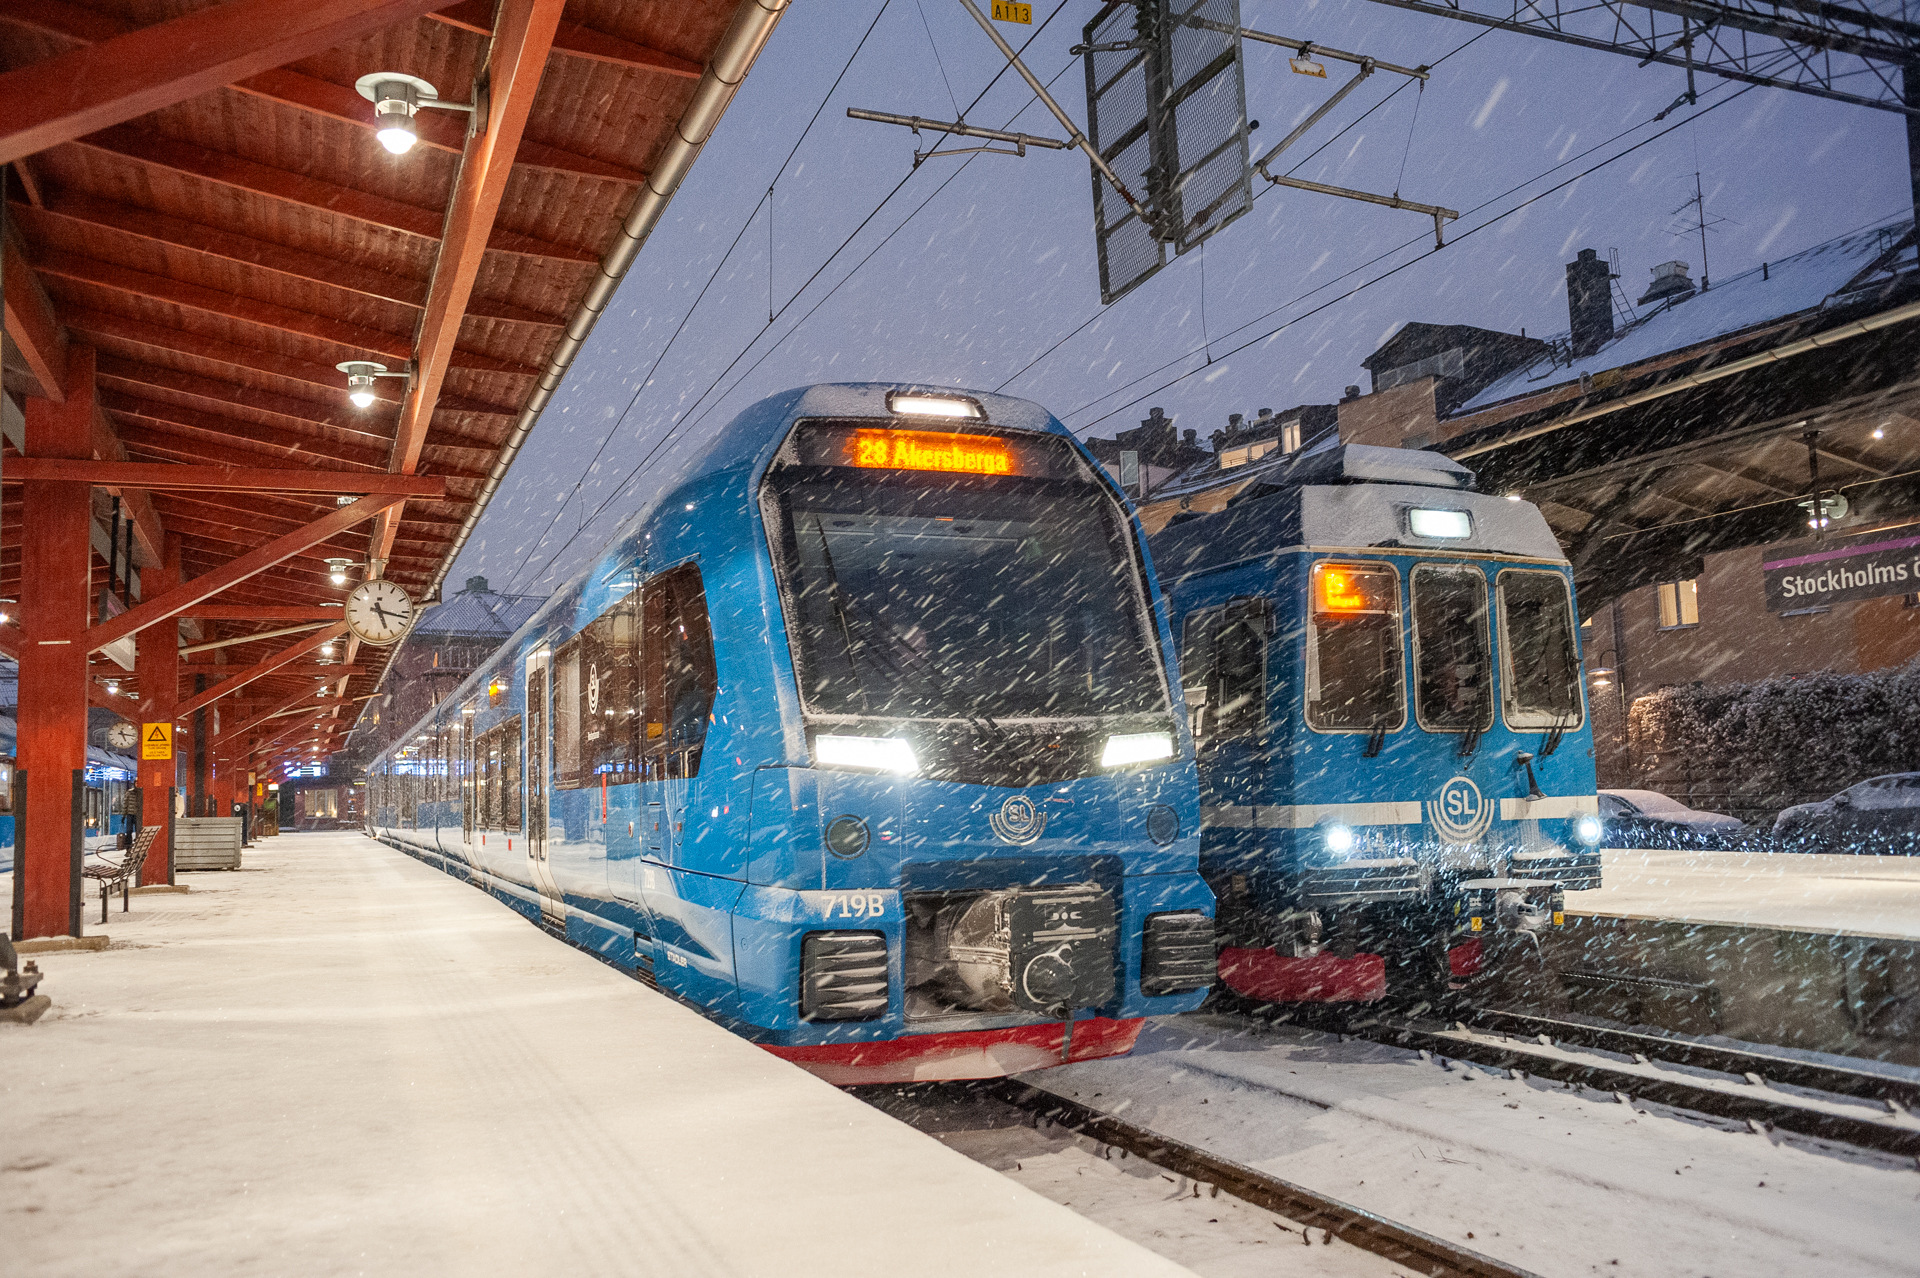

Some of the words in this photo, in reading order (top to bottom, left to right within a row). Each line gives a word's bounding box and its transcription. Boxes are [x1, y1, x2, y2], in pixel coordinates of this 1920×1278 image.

[995, 5, 1029, 21] A113
[859, 440, 887, 464] 28
[894, 439, 1008, 474] Åkersberga
[1782, 563, 1908, 597] Stockholms
[1009, 804, 1029, 822] SL
[1447, 789, 1476, 815] SL
[820, 894, 885, 917] 719B
